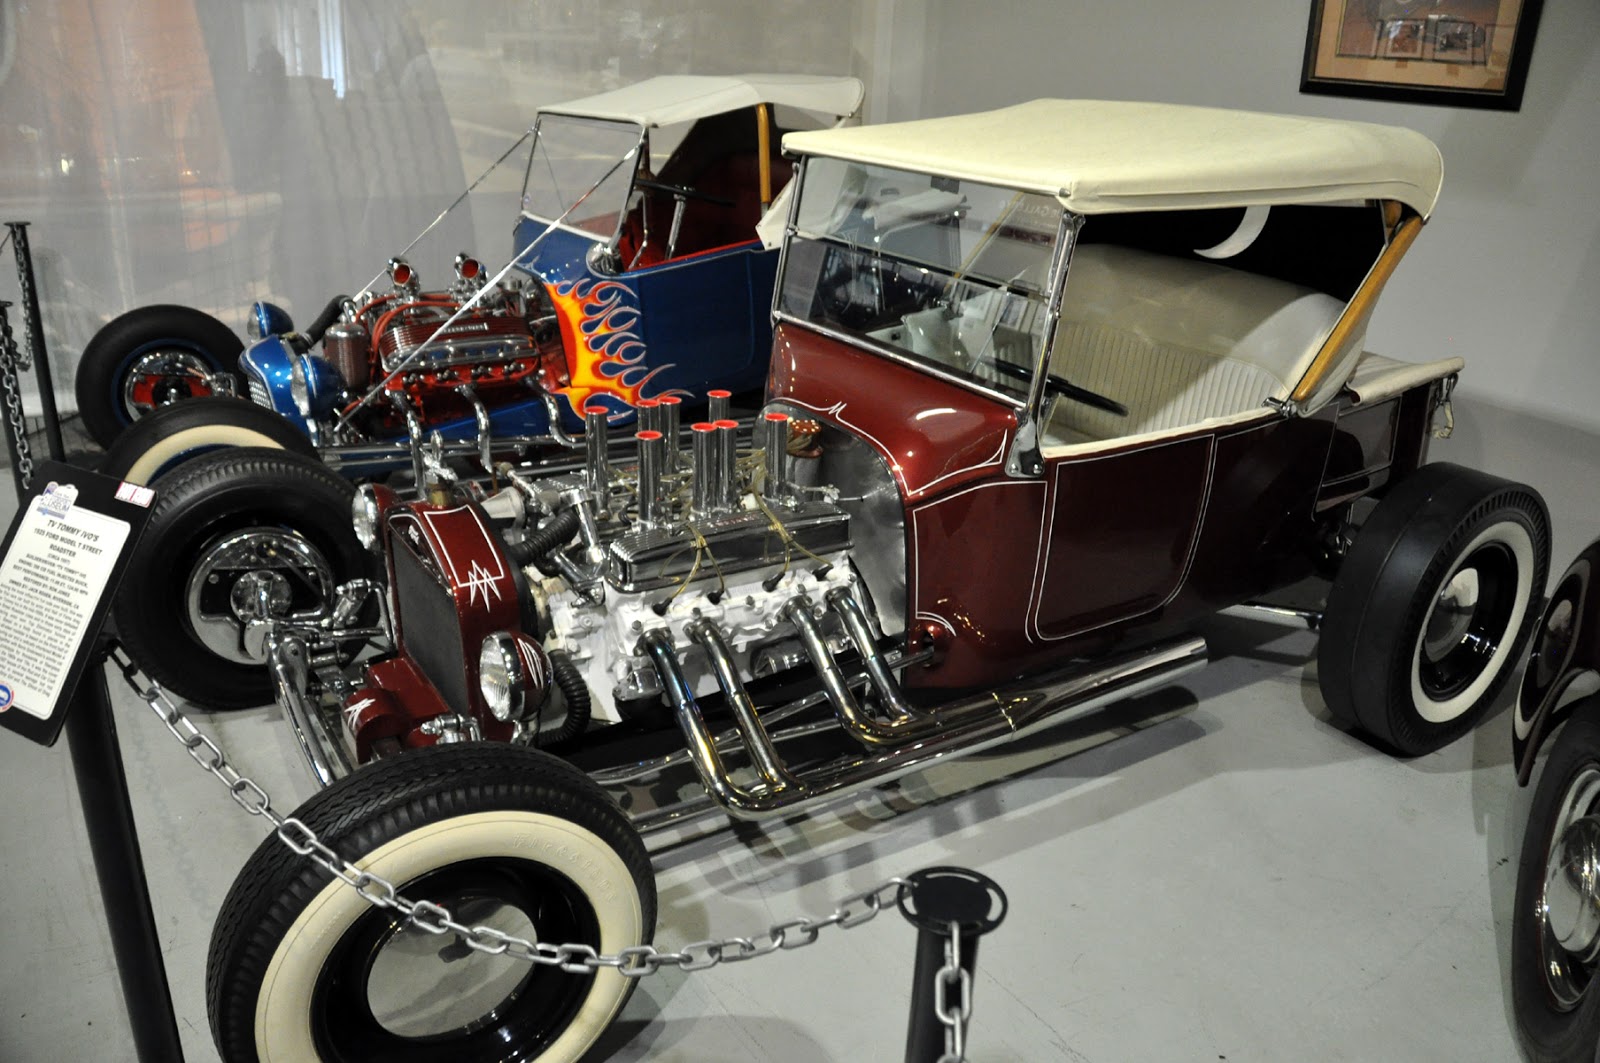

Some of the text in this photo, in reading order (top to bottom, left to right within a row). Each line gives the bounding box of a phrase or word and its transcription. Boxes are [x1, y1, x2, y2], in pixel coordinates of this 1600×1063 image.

[48, 520, 99, 542] TV TOMMY IVO'S
[45, 532, 59, 540] FORD
[60, 537, 77, 546] MODEL
[82, 545, 103, 555] STREET
[49, 544, 76, 557] ROADSTER
